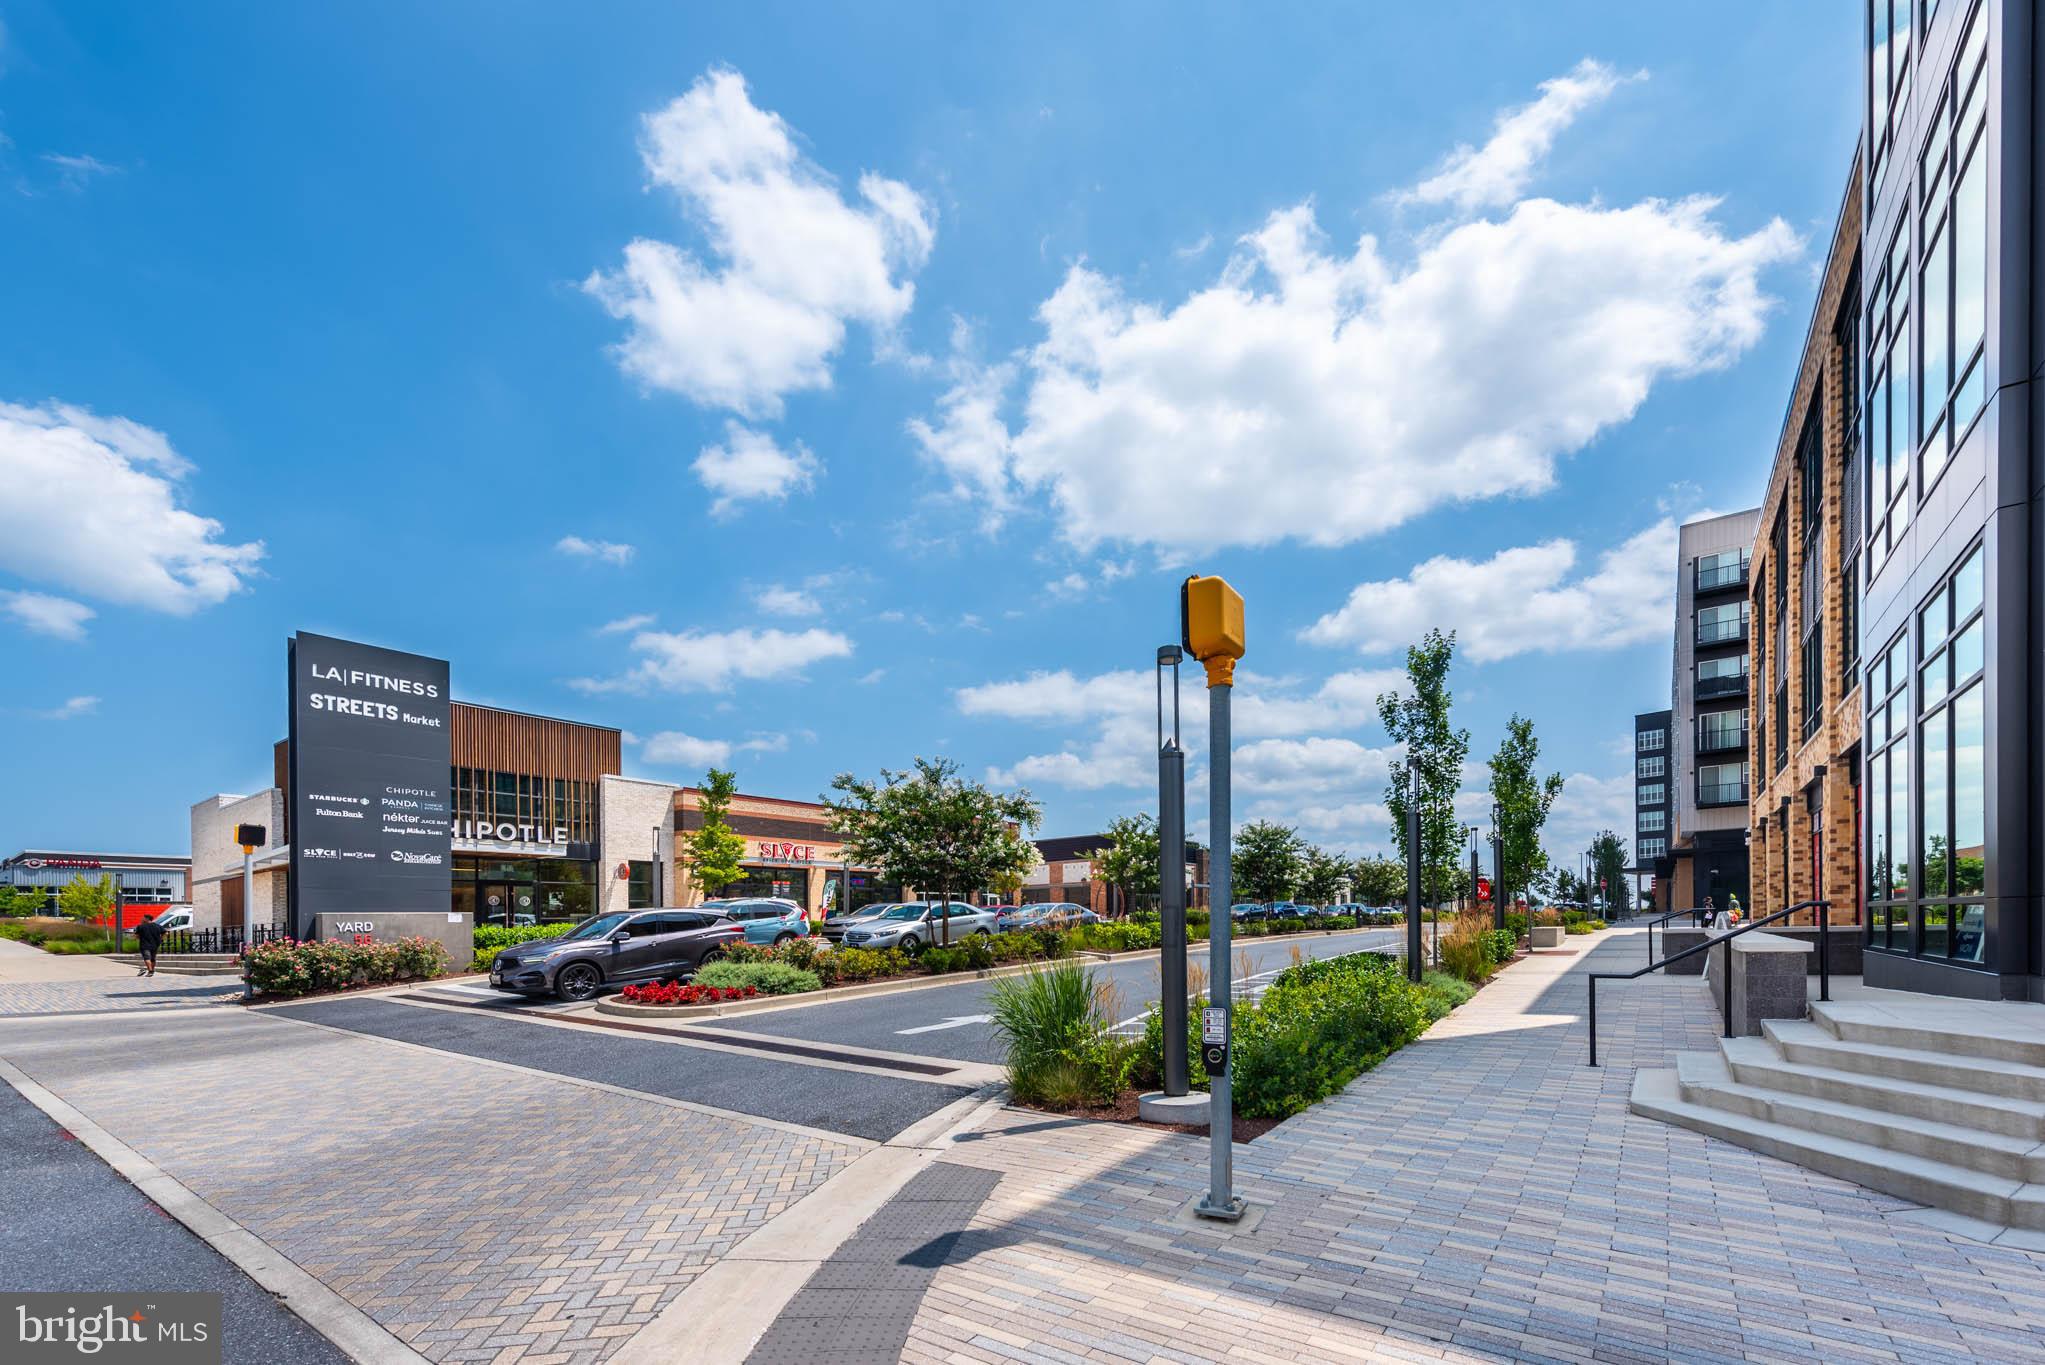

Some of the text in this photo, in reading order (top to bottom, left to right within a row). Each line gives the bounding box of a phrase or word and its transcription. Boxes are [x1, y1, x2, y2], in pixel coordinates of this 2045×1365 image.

[351, 670, 438, 698] FITNESS
[310, 693, 441, 728] STREETS Market
[385, 786, 437, 798] CHIPOTLE
[381, 798, 419, 808] PANDA
[315, 808, 364, 819] Fulton Bank
[451, 819, 569, 845] HIPOTLE
[336, 921, 374, 933] YARD
